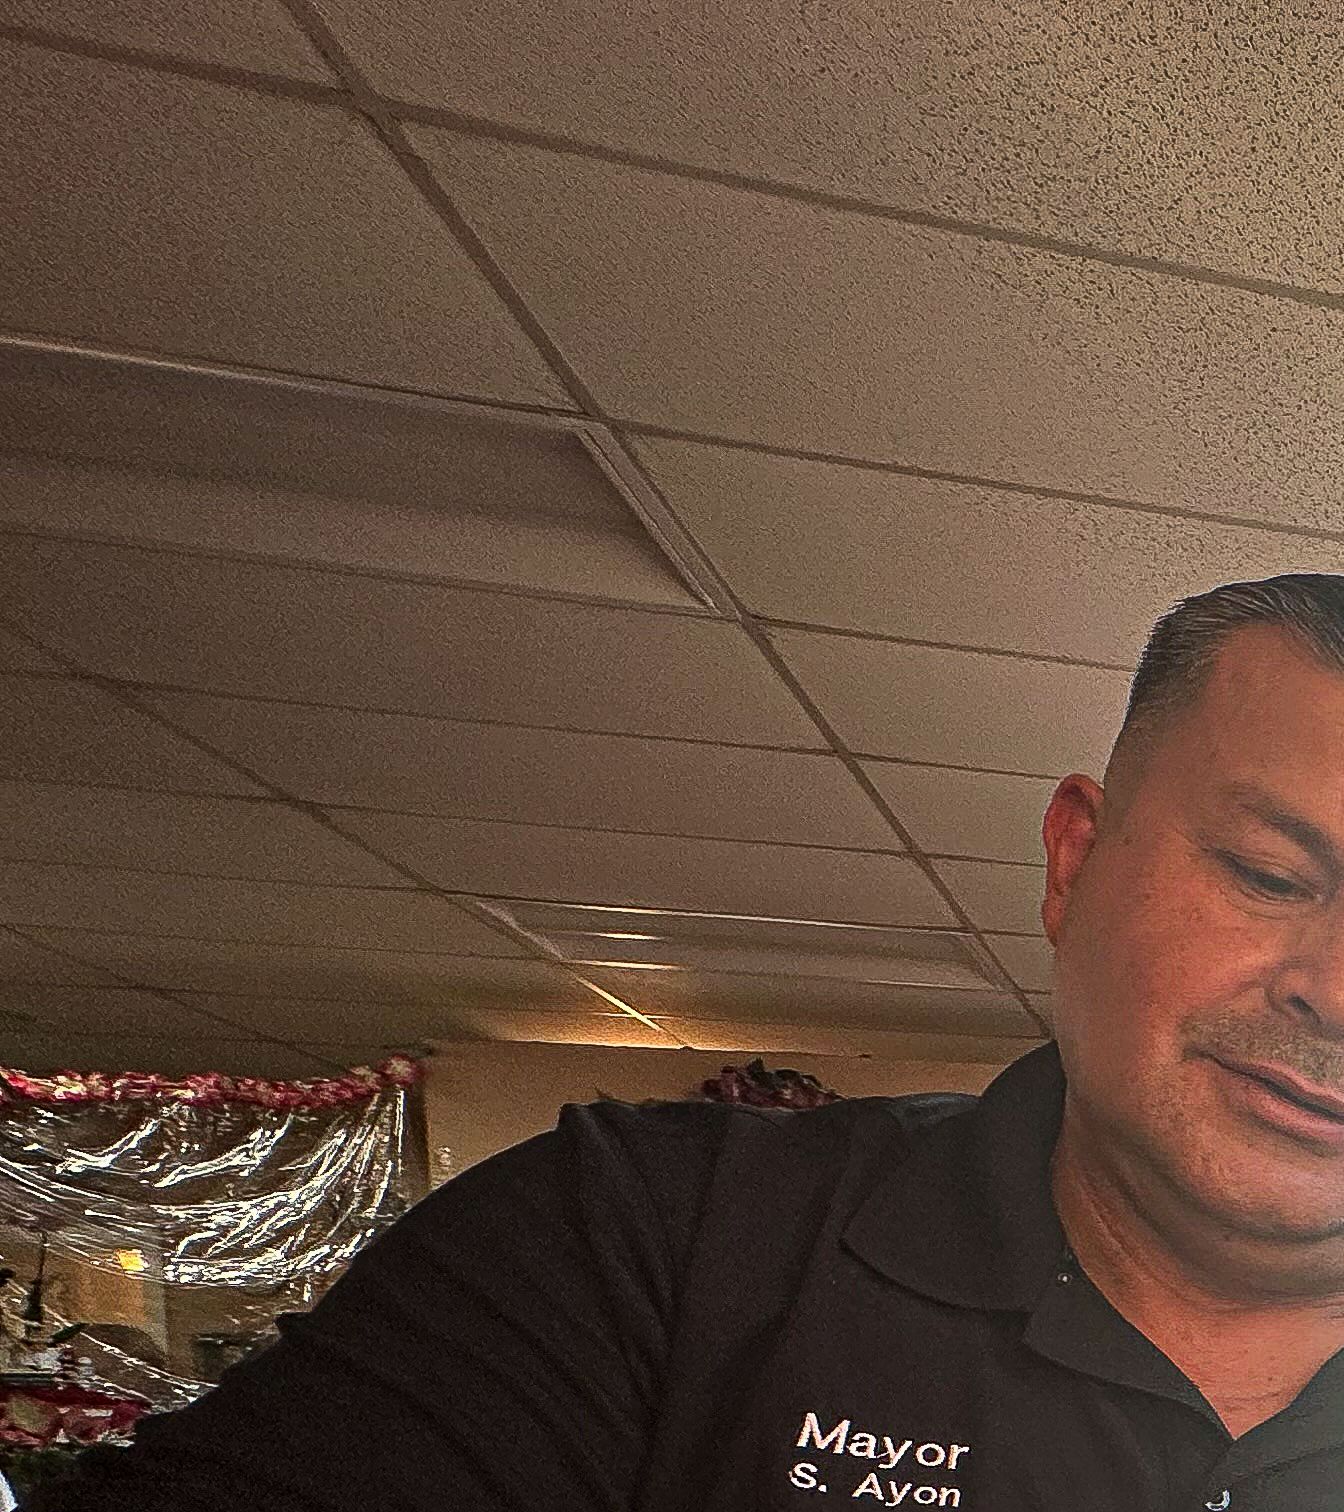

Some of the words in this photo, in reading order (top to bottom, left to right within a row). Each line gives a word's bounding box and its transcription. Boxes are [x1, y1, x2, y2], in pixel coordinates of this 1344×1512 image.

[795, 1411, 970, 1471] Mayor
[788, 1461, 828, 1494] S.
[851, 1472, 962, 1508] Ayon
